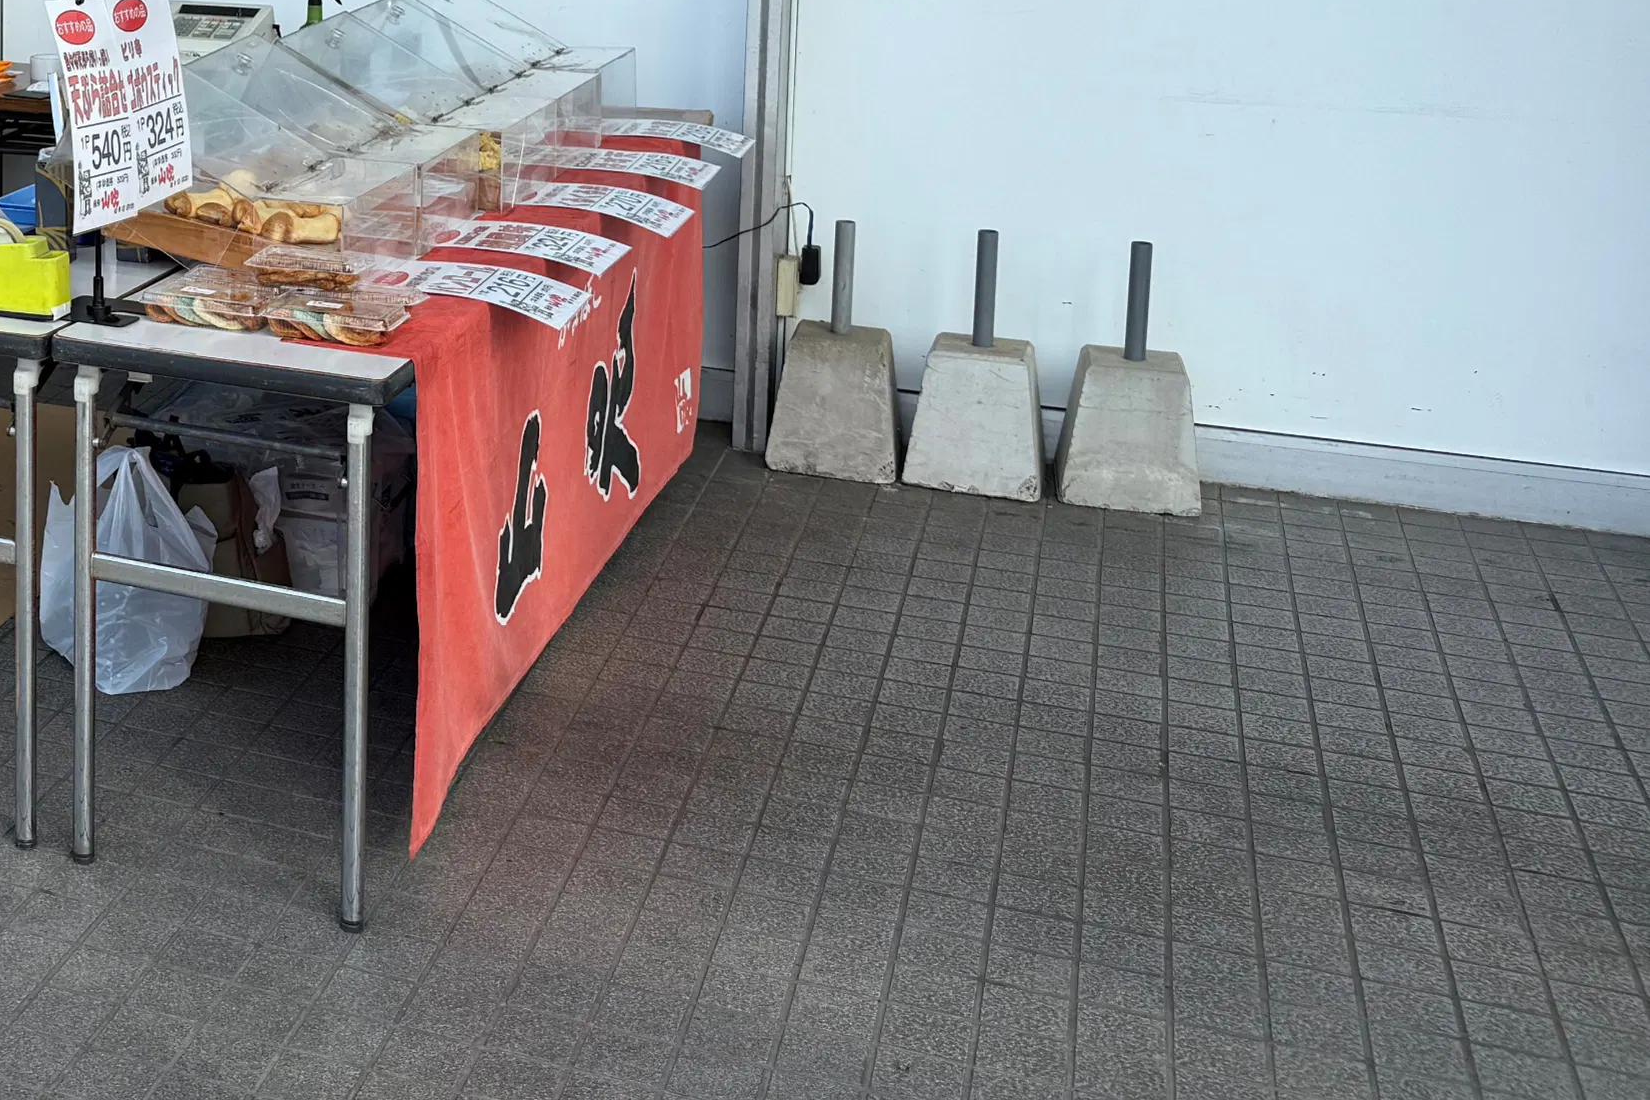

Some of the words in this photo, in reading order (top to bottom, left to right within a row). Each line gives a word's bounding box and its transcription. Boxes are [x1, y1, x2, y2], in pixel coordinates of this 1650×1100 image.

[113, 4, 147, 23] おすすめの品
[56, 18, 94, 35] おすすめの品
